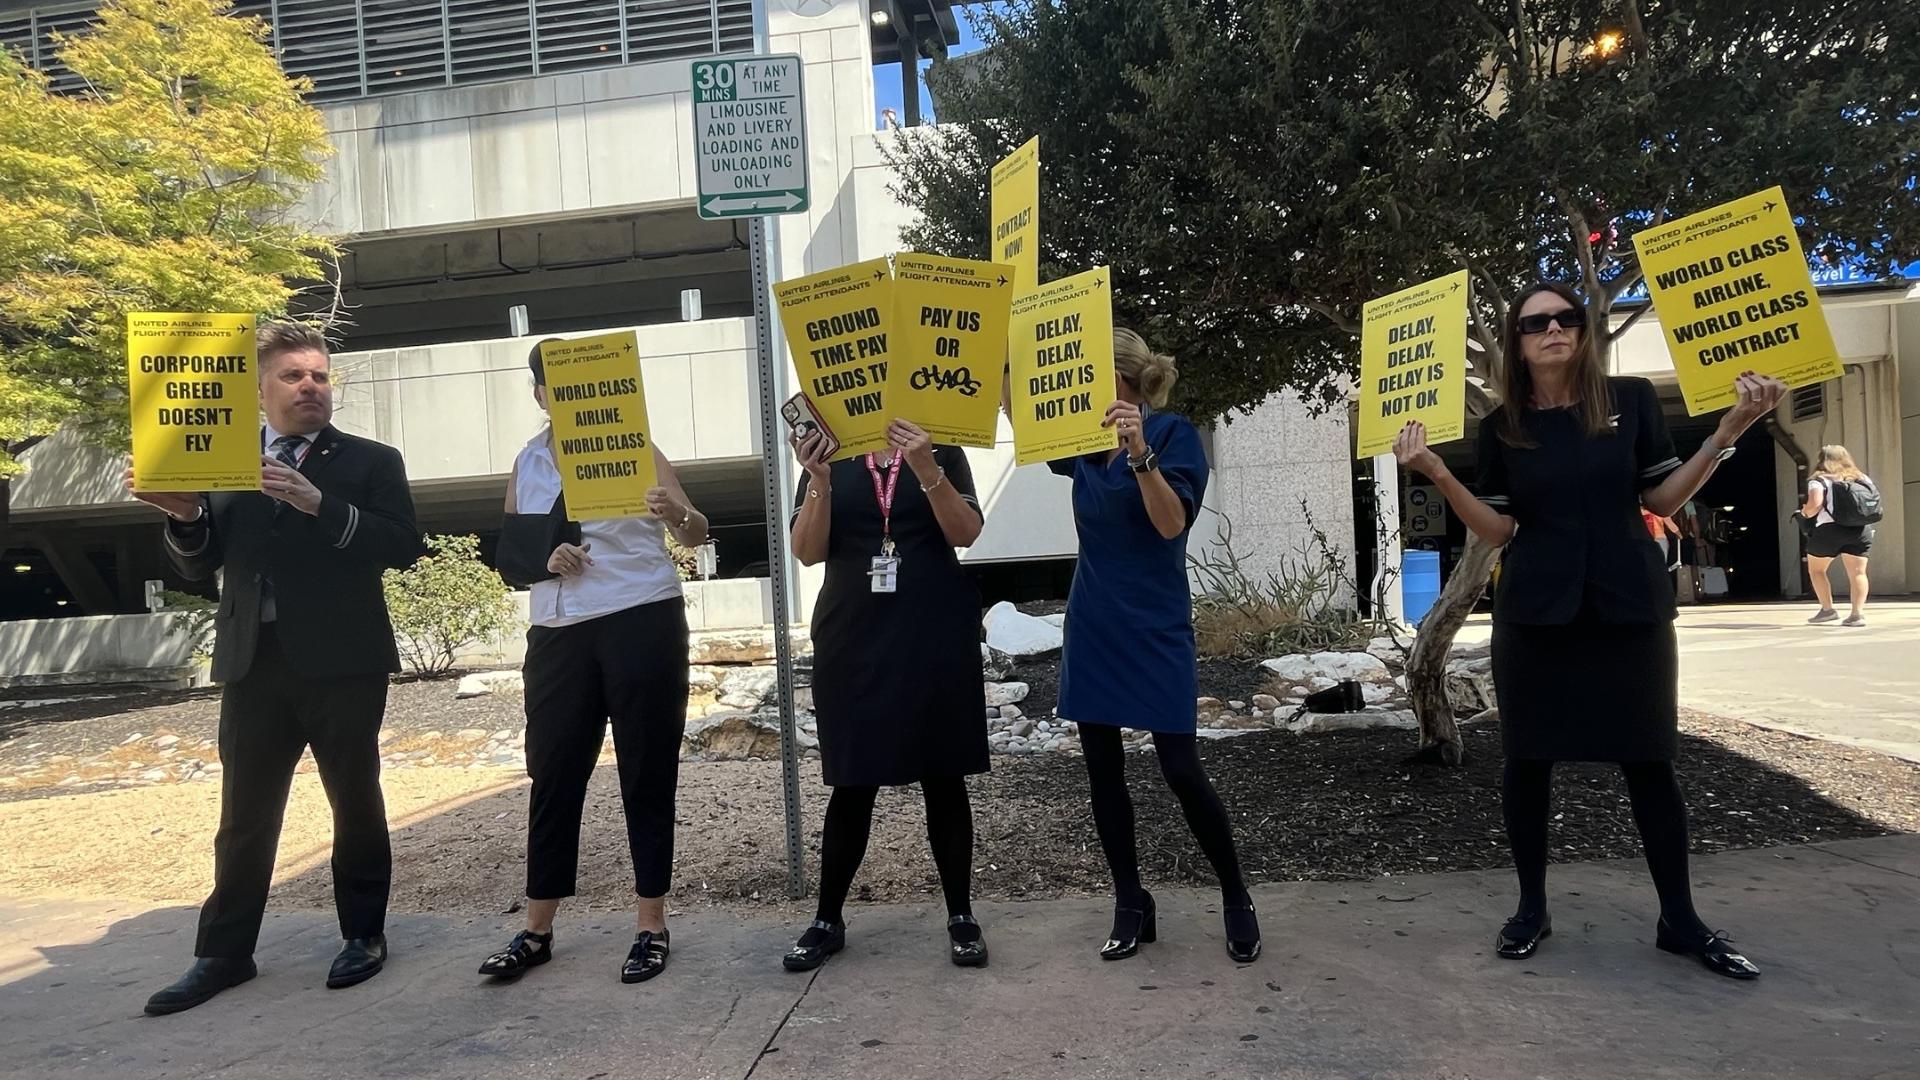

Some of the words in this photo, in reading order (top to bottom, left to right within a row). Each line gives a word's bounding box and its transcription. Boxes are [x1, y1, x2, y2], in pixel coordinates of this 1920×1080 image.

[696, 63, 735, 89] 30
[743, 66, 756, 79] AT
[764, 64, 788, 78] ANY
[702, 89, 731, 101] MINS
[752, 80, 781, 94] TIME
[711, 101, 788, 119] LIMOUSINE
[707, 123, 735, 137] AND
[744, 118, 793, 135] LIVERY
[702, 138, 762, 155] LOADING
[770, 136, 799, 151] AND
[712, 154, 793, 172] UNLOADING
[734, 174, 770, 189] ONLY
[997, 206, 1032, 242] CONTRACT
[1642, 229, 1680, 246] UNITED
[1685, 211, 1733, 232] AIRLINES
[1645, 240, 1681, 256] FLIGHT
[1685, 214, 1758, 243] ATTENDANTS
[1004, 236, 1023, 261] NOW!
[900, 261, 934, 271] UNITED
[936, 265, 975, 276] AIRLINES
[1655, 256, 1725, 291] WORLD
[1727, 235, 1790, 268] CLASS
[1810, 265, 1844, 281] evel
[779, 284, 811, 298] UNITED
[813, 274, 851, 290] AIRLINES
[900, 272, 931, 281] FLIGHT
[933, 276, 992, 289] ATTENDANTS
[1693, 273, 1771, 309] AIRLINE,
[781, 295, 811, 308] FLIGHT
[813, 281, 871, 300] ATTENDANTS
[1012, 294, 1039, 306] UNITED
[1040, 284, 1074, 298] AIRLINES
[1012, 304, 1038, 316] FLIGHT
[1039, 289, 1090, 309] ATTENDANTS
[1368, 302, 1394, 314] UNITED
[1396, 289, 1430, 304] AIRLINES
[920, 306, 953, 329] PAY
[956, 310, 981, 333] US
[1367, 311, 1392, 322] FLIGHT
[1394, 293, 1446, 314] ATTENDANTS
[1673, 310, 1743, 345] WORLD
[1745, 290, 1810, 323] CLASS
[806, 307, 881, 342] GROUND
[1036, 313, 1083, 342] DELAY,
[1389, 316, 1436, 345] DELAY,
[546, 348, 571, 357] UNITED
[573, 344, 604, 353] AIRLINES
[810, 342, 856, 369] TIME
[857, 333, 887, 359] PAY
[935, 336, 960, 358] OR
[1037, 340, 1084, 368] DELAY,
[1388, 341, 1435, 368] DELAY,
[1699, 323, 1800, 366] CONTRACT
[140, 355, 247, 373] CORPORATE
[547, 358, 573, 367] FLIGHT
[573, 352, 620, 363] ATTENDANTS
[166, 382, 223, 399] GREED
[553, 383, 597, 402] WORLD
[598, 378, 637, 397] CLASS
[813, 367, 868, 397] LEADS
[1029, 368, 1074, 397] DELAY
[1078, 364, 1095, 385] IS
[1378, 367, 1424, 395] DELAY
[1428, 362, 1444, 382] IS
[843, 391, 883, 417] WAY
[1035, 397, 1065, 422] NOT
[1069, 391, 1092, 414] OK
[1381, 395, 1412, 418] NOT
[1416, 388, 1438, 409] OK
[159, 408, 233, 425] DOESN'T
[575, 408, 623, 427] AIRLINE,
[185, 434, 213, 452] FLY
[561, 437, 604, 455] WORLD
[606, 432, 645, 451] CLASS
[575, 460, 637, 480] CONTRACT
